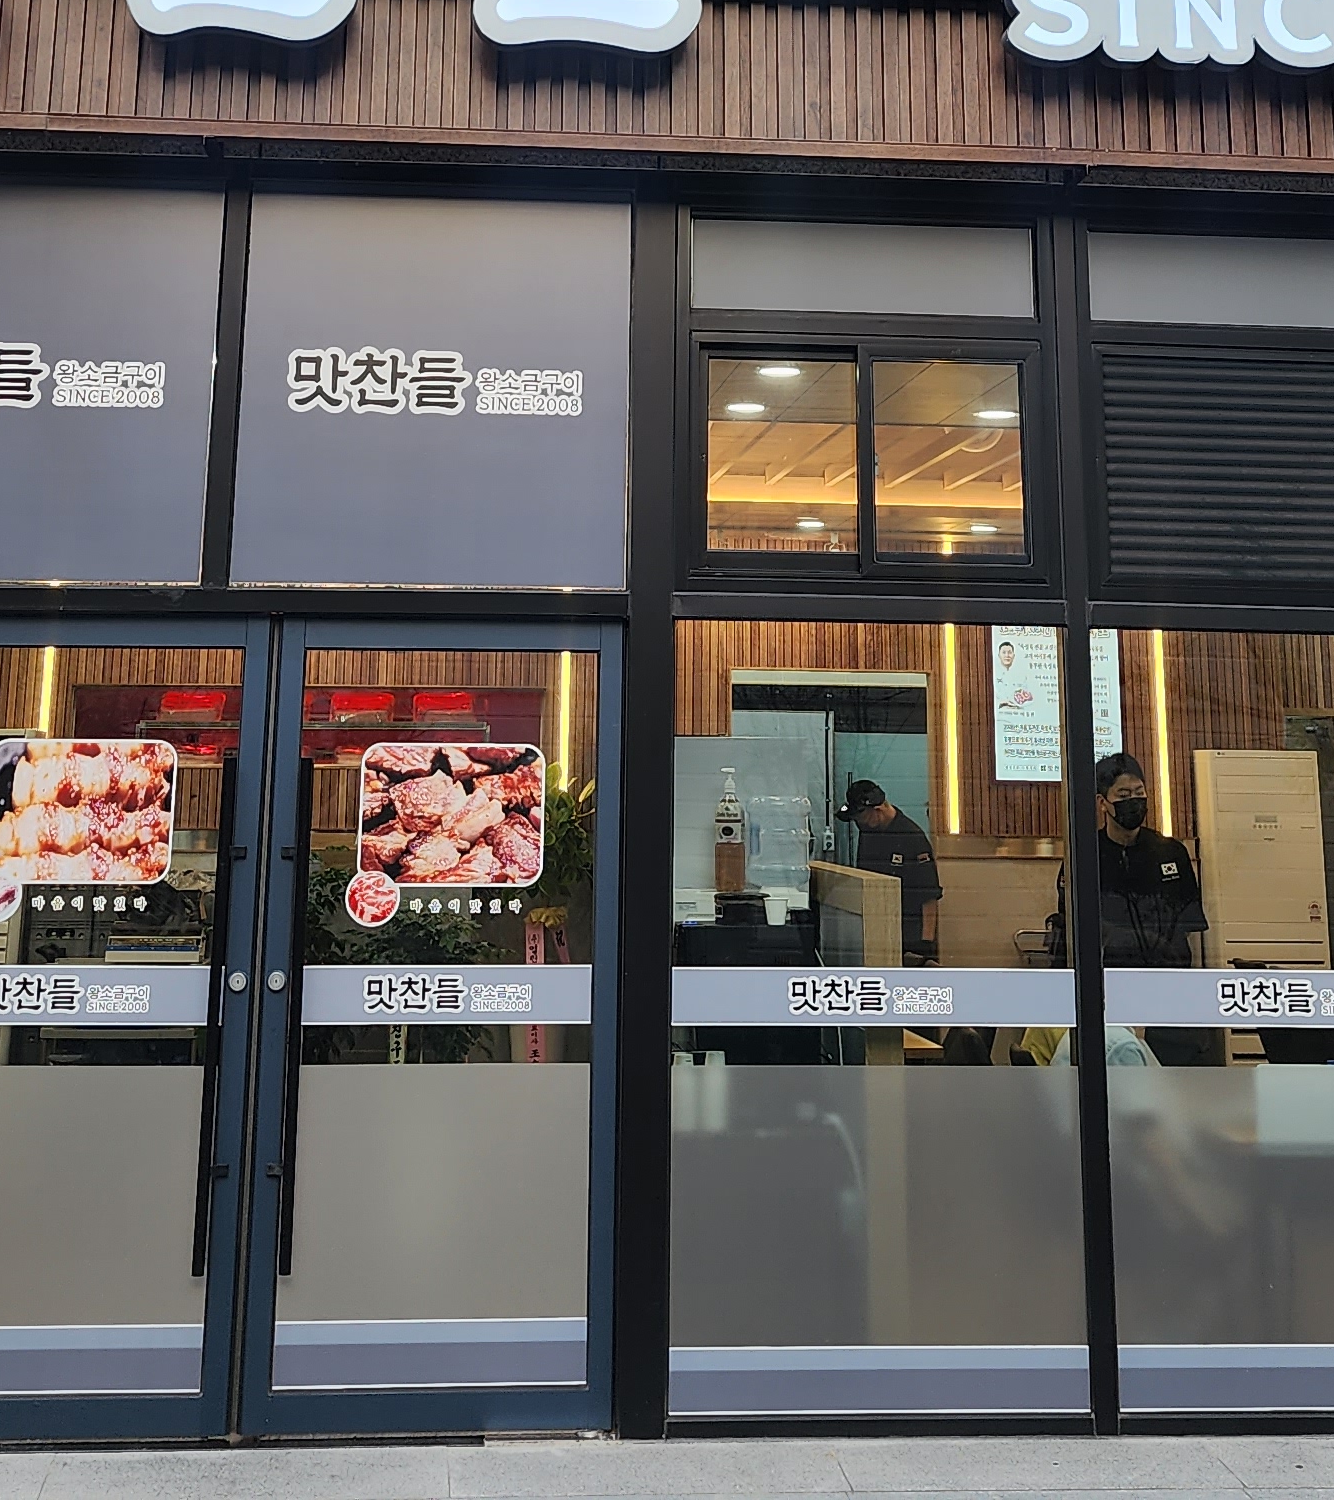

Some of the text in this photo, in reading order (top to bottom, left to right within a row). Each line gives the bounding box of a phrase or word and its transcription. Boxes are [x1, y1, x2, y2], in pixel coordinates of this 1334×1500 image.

[56, 362, 165, 388] 왕소금구이
[293, 352, 584, 410] 맛찬들 왕소금구이
[56, 388, 162, 406] SINCE 2008
[476, 396, 582, 414] SINCE 2008
[86, 985, 150, 1001] 왕소금구이
[364, 975, 532, 1011] 맛찬들 왕소금구이
[790, 977, 953, 1014] 맛찬들 왕소금구이
[1218, 978, 1314, 1016] 맛찬들
[86, 1001, 148, 1012] SINCE 2008
[470, 1001, 531, 1012] SINCE 2008
[893, 1003, 953, 1014] SINCE 2008
